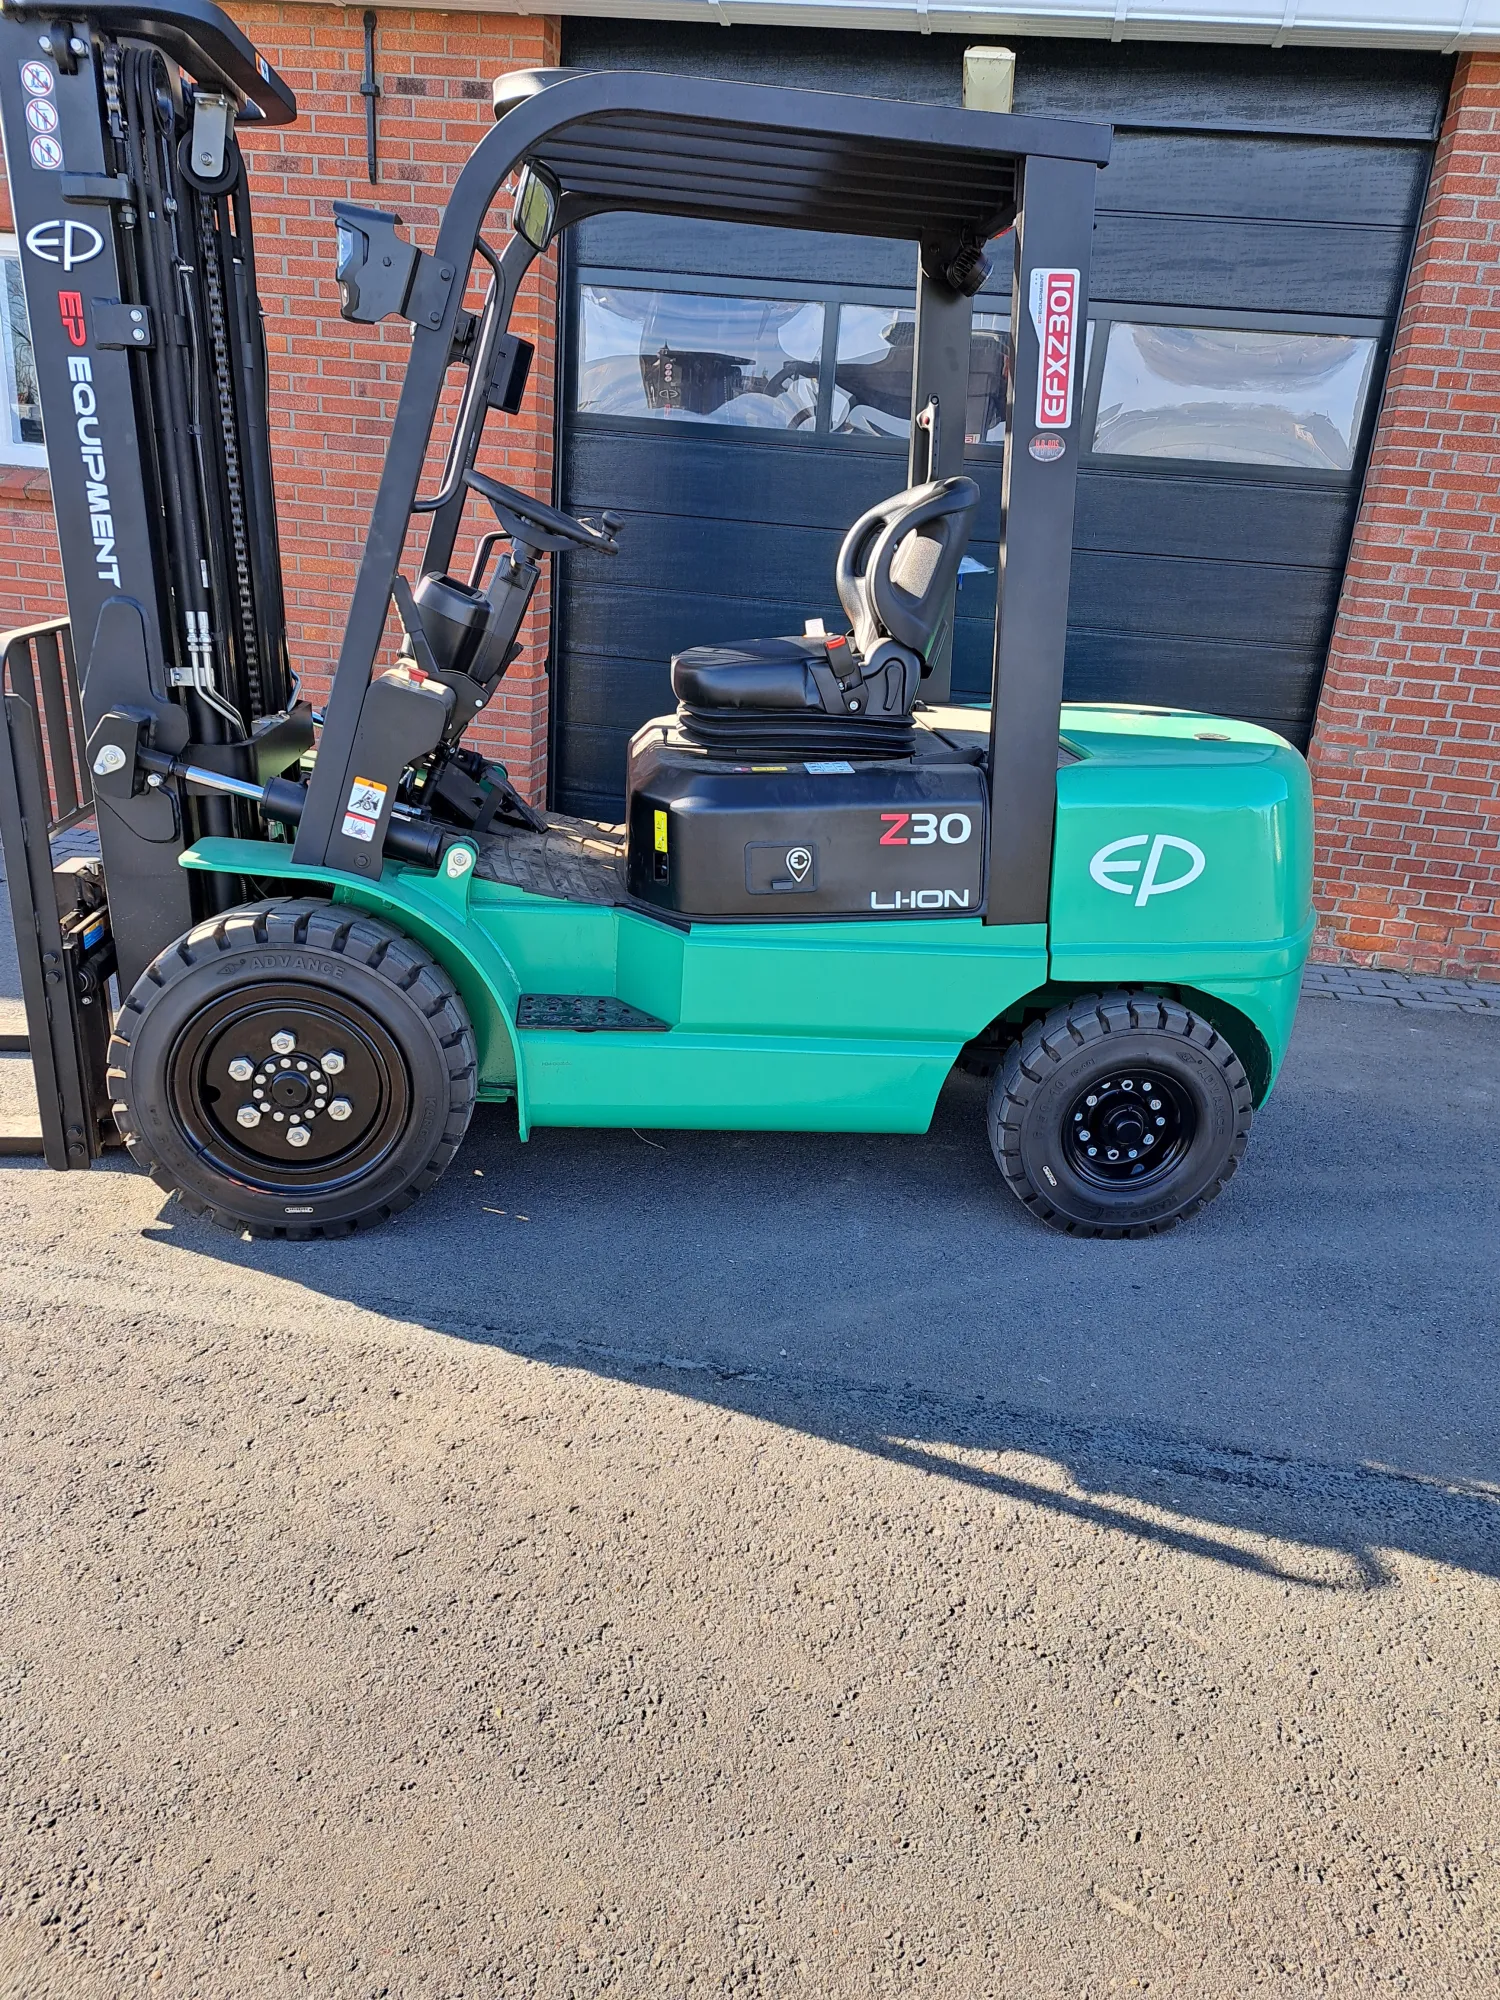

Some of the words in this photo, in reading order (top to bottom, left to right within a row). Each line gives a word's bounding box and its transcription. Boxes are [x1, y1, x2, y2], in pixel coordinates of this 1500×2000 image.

[57, 290, 88, 347] EP
[1044, 281, 1071, 417] EFXZ301
[67, 355, 122, 589] EQUIPMENT
[879, 812, 972, 846] Z30
[1089, 833, 1206, 907] EP
[870, 889, 970, 910] LI-ION
[250, 954, 346, 979] ADVANCE
